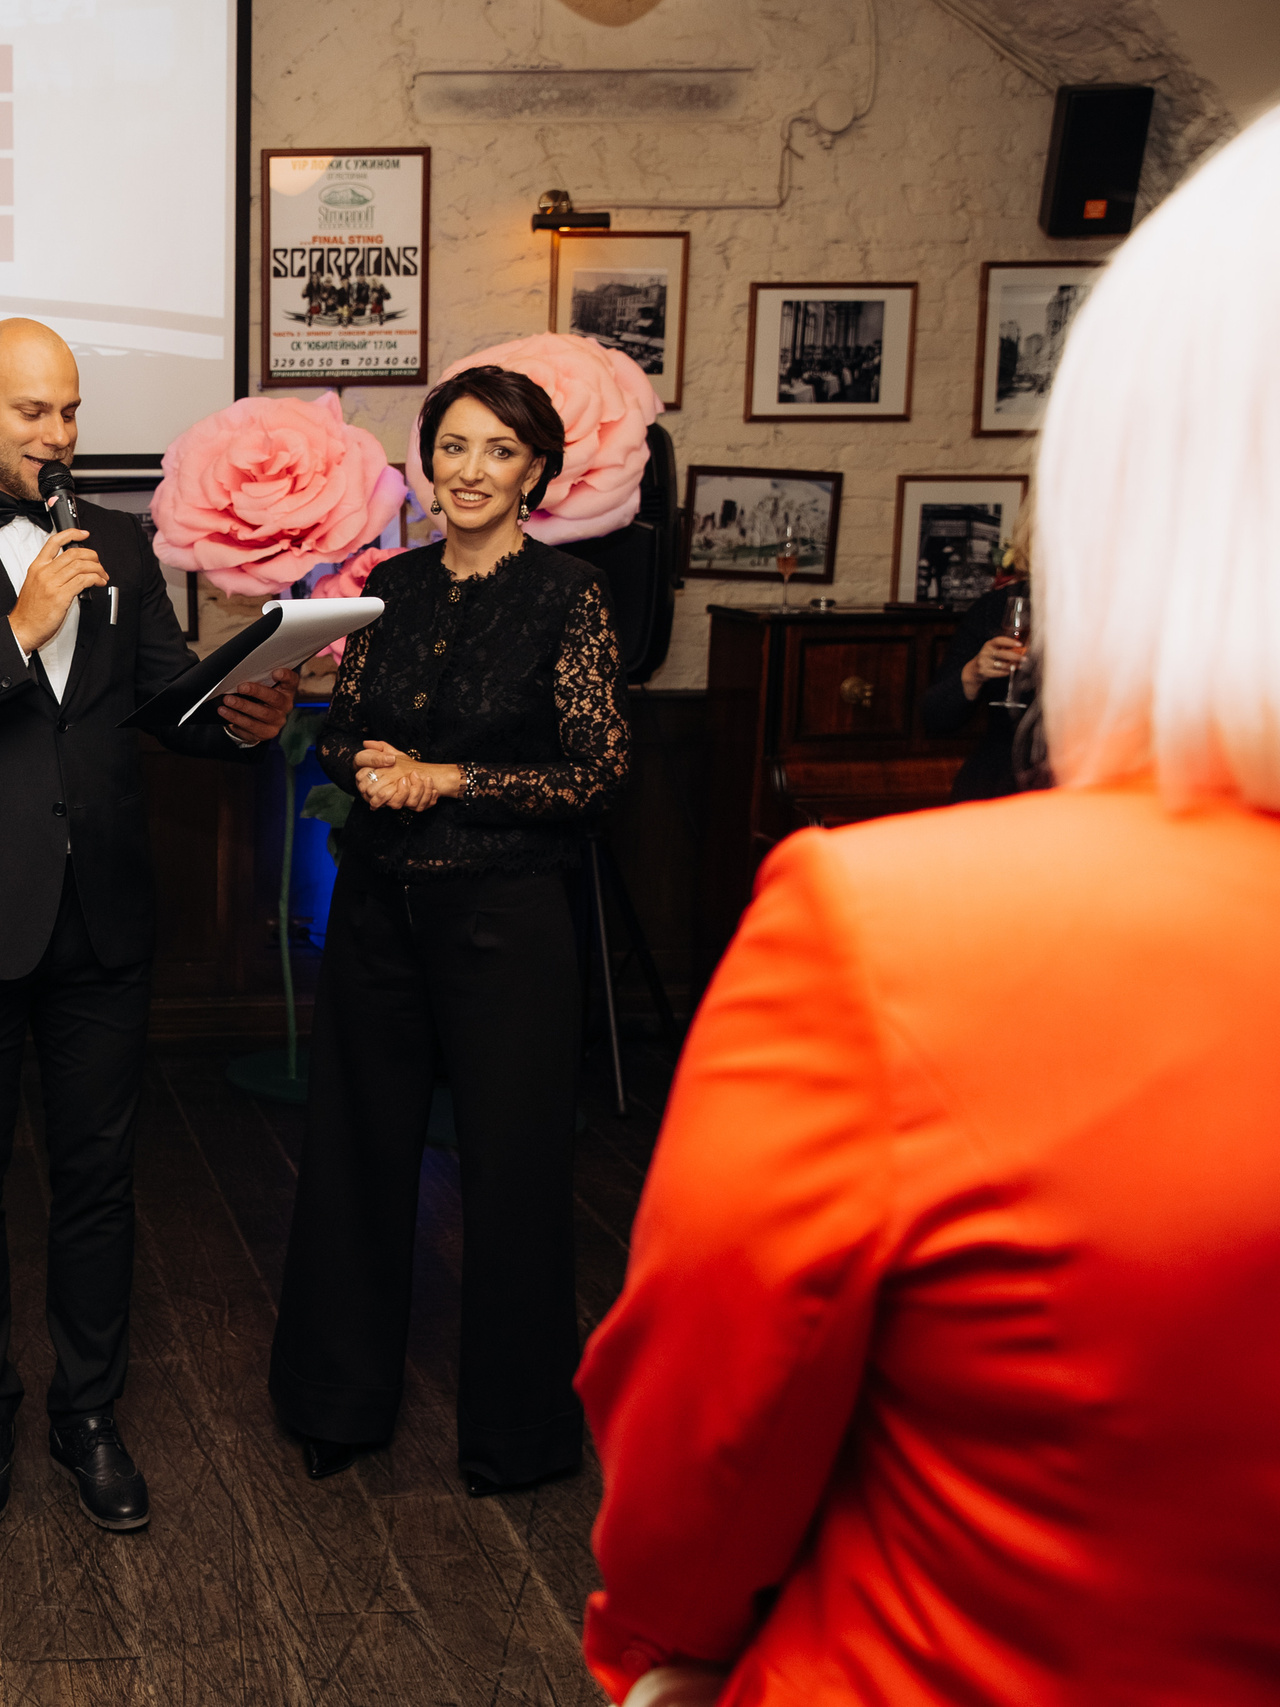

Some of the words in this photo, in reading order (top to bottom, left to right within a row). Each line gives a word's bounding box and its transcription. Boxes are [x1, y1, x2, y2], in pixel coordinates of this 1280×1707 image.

[345, 158, 352, 170] С
[354, 158, 400, 170] УЖИНОМ
[348, 235, 384, 244] STING
[273, 247, 418, 278] SCORPIONS
[291, 340, 302, 351] СК
[374, 339, 398, 351] 17/04
[273, 358, 295, 368] 329
[299, 357, 314, 367] 60
[318, 357, 333, 367] 50
[358, 356, 379, 367] 703
[383, 356, 398, 366] 40
[403, 356, 418, 366] 40
